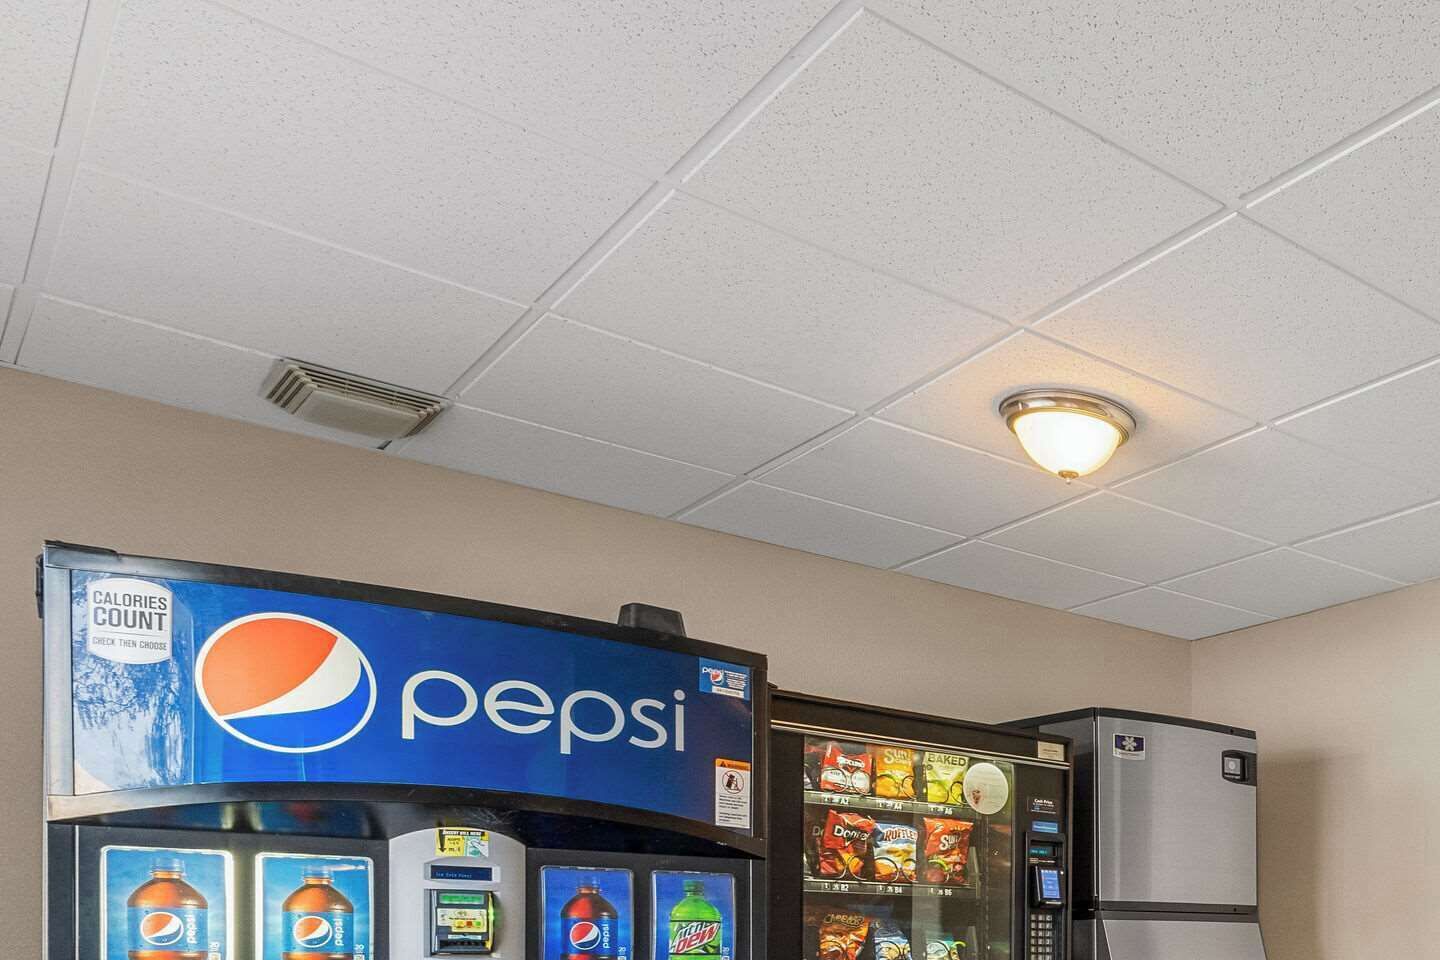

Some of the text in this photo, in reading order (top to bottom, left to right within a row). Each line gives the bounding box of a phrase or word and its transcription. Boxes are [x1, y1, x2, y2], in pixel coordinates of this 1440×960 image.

[93, 590, 168, 611] CALORIES
[93, 607, 168, 632] COUNT
[92, 636, 167, 651] CHECK THEN CHOOSE
[402, 670, 686, 755] pepsi
[928, 753, 966, 767] BAKED
[186, 914, 198, 944] pepsi
[334, 917, 344, 946] pepsi
[602, 924, 610, 949] pepsi
